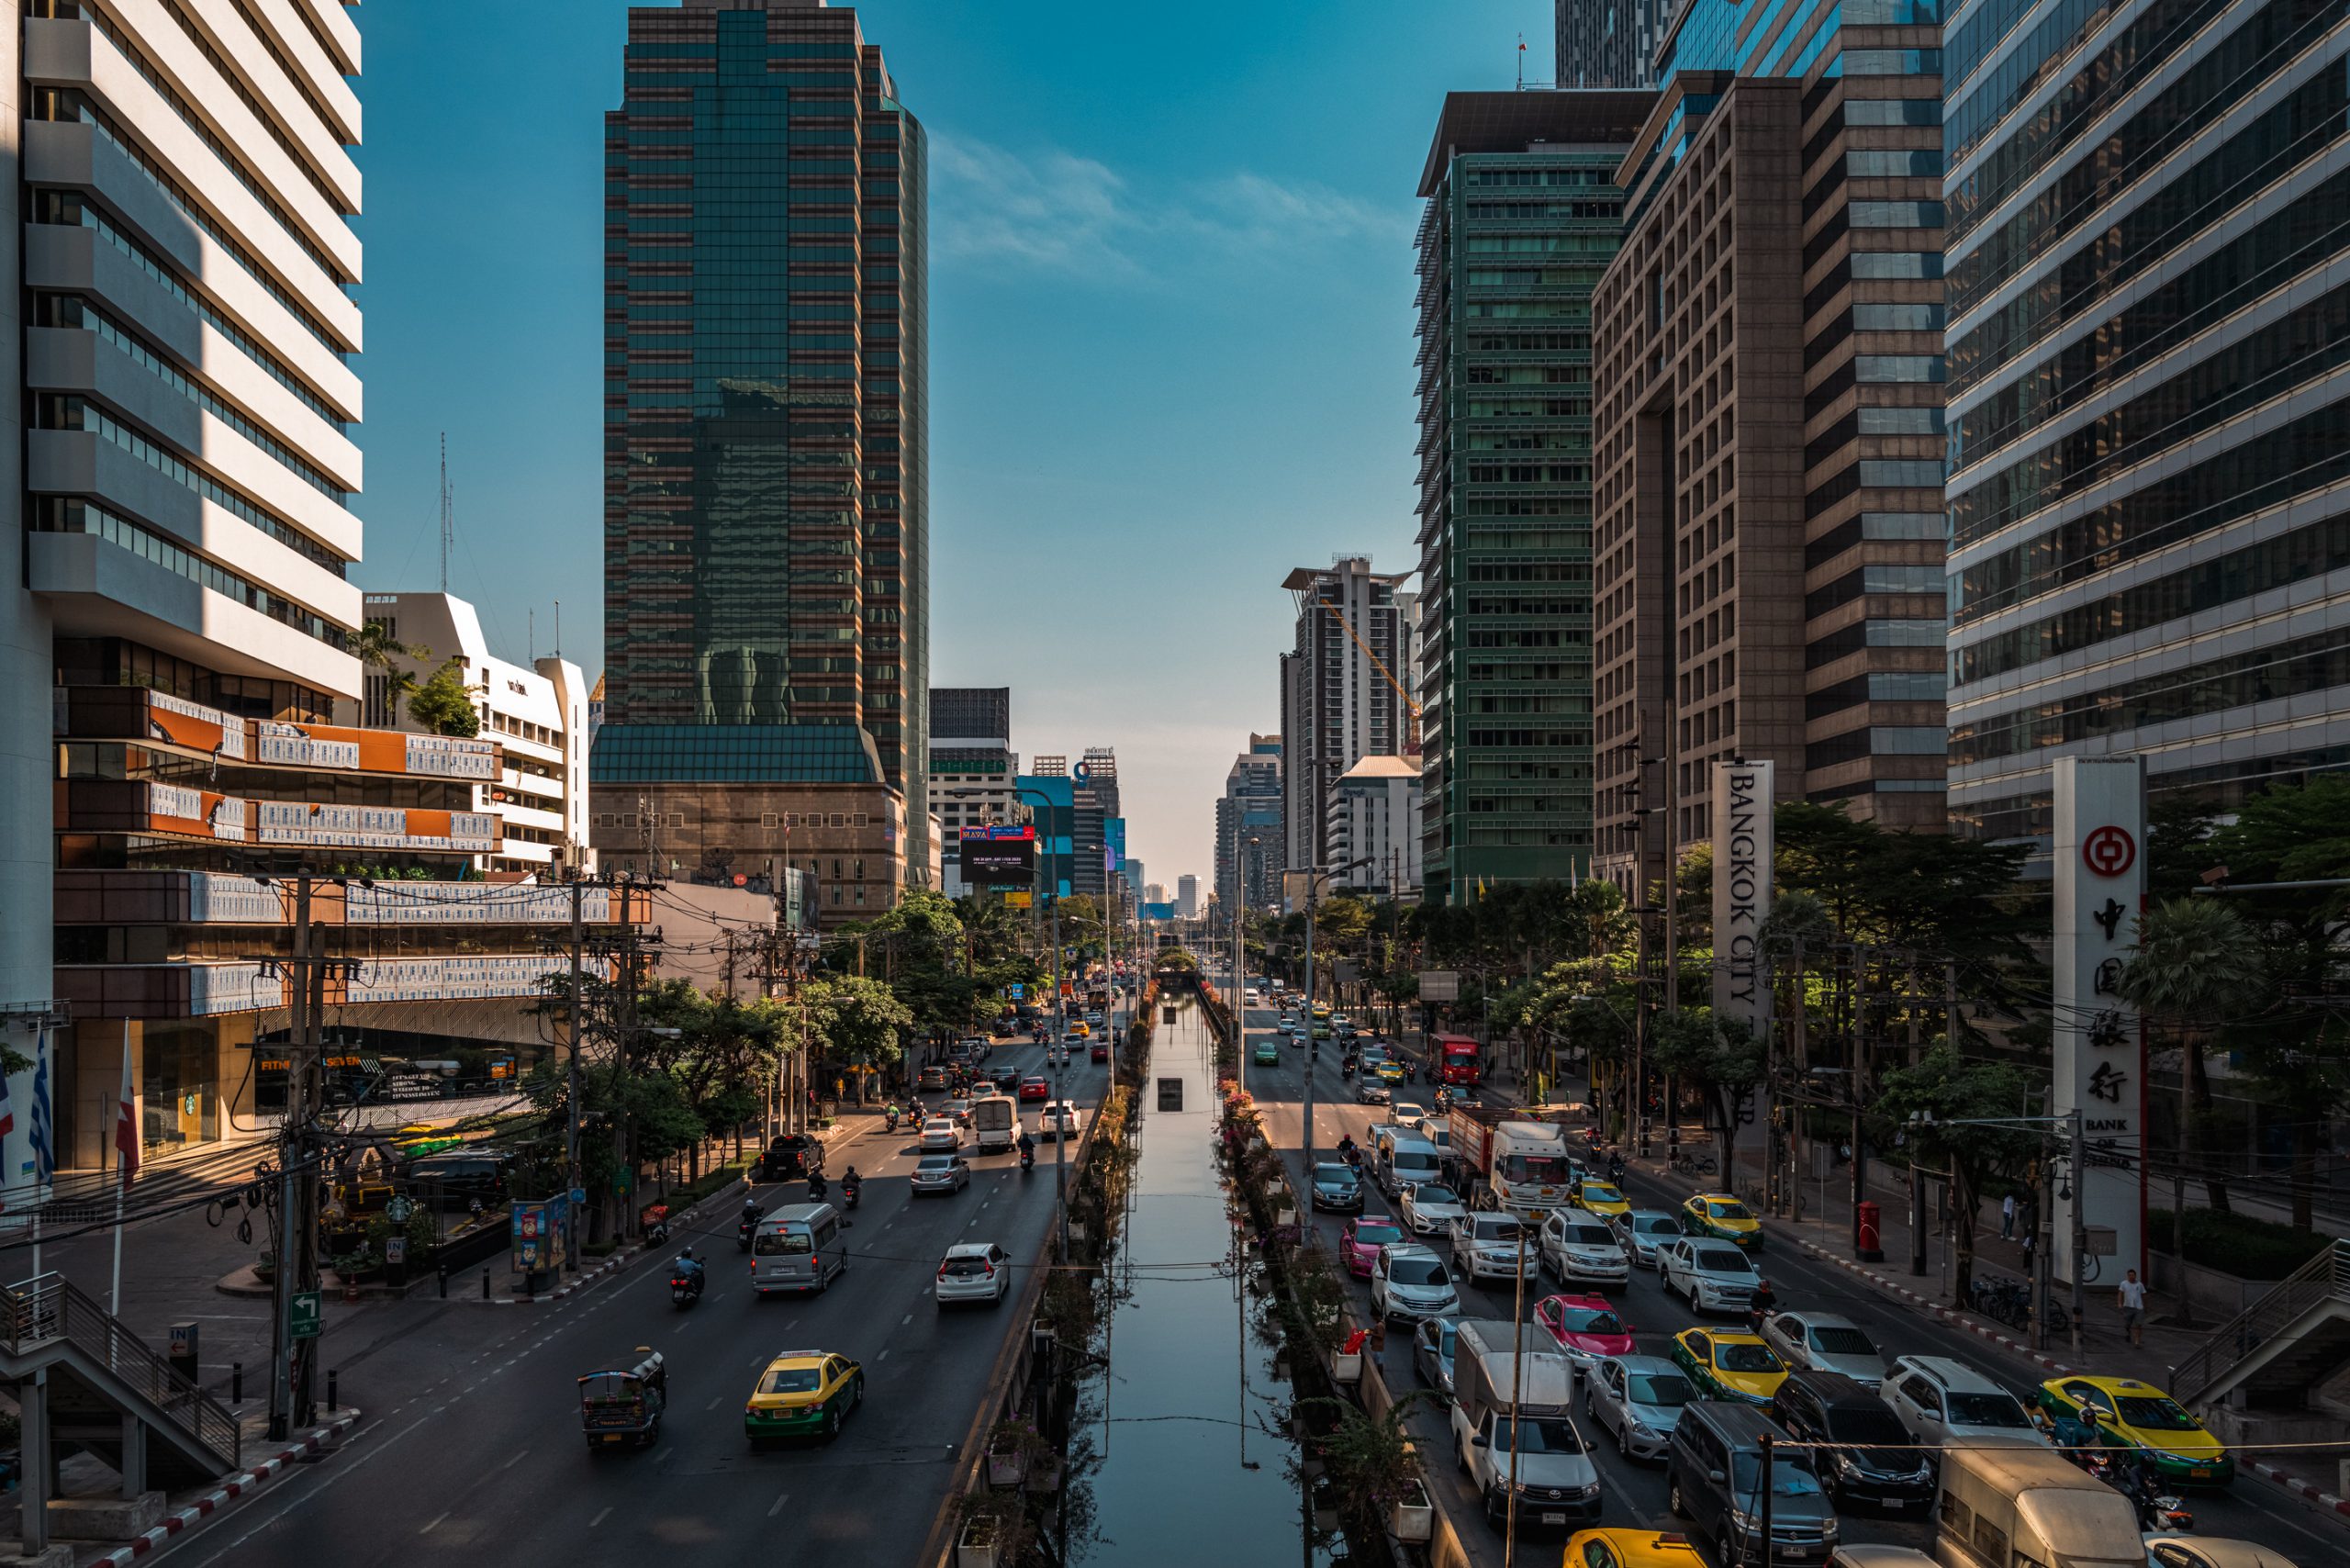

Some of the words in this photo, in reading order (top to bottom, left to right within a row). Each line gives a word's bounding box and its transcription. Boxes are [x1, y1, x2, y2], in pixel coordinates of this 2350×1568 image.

[1729, 772, 1755, 924] BANGKOK
[1729, 934, 1755, 1006] CITY
[2086, 1119, 2128, 1131] BANK
[388, 1242, 401, 1250] IN
[171, 1330, 185, 1340] IN
